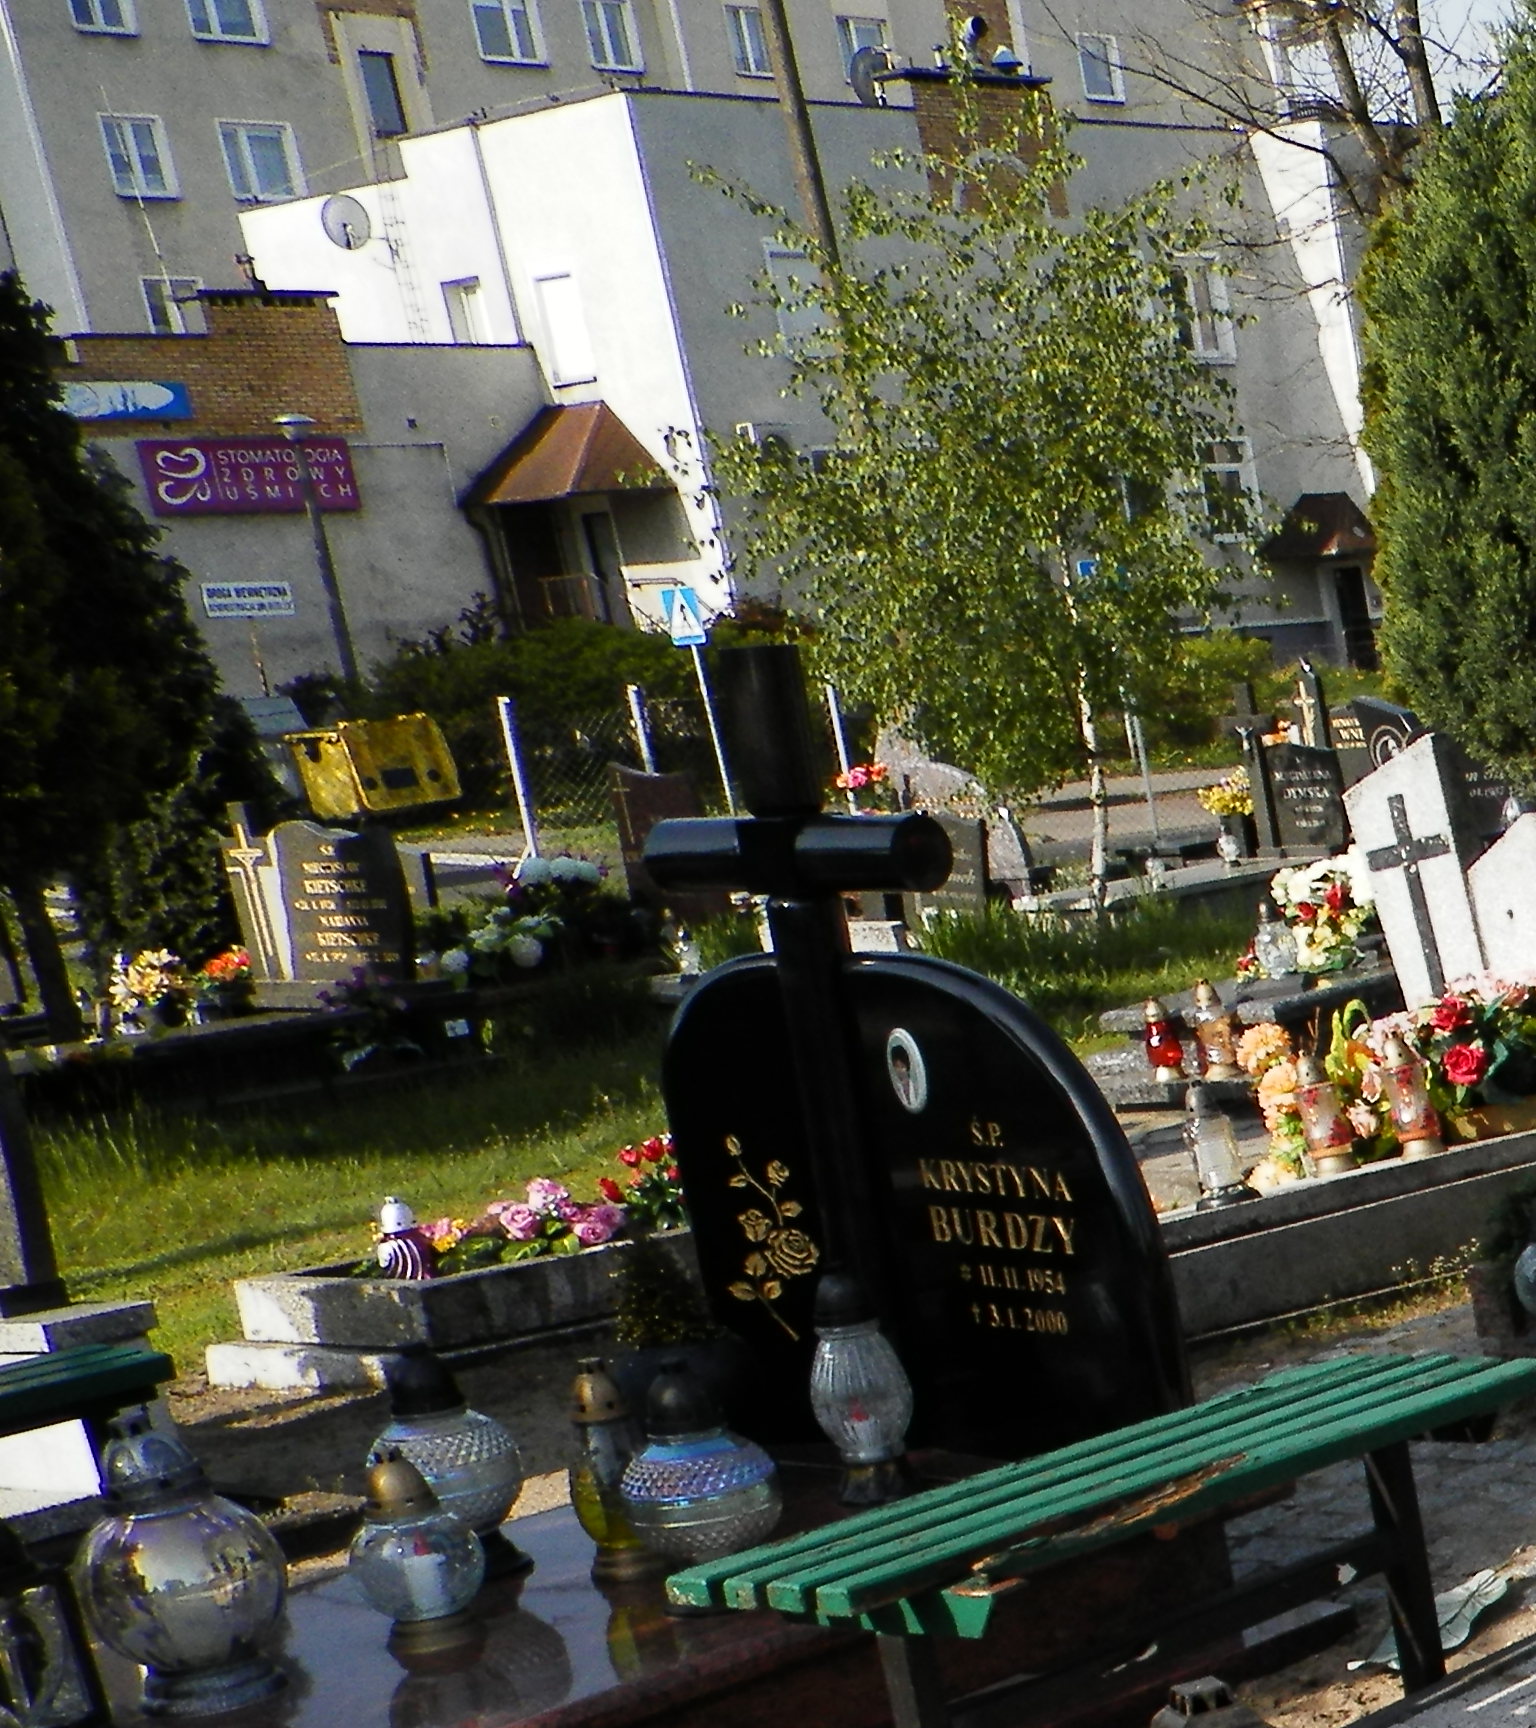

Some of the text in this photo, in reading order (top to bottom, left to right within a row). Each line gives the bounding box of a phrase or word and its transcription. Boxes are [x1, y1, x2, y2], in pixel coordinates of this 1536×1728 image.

[217, 448, 343, 465] STOMATOOGIA
[226, 482, 352, 501] UŚMICH
[919, 1158, 1073, 1202] KRYSTYNA
[928, 1205, 1075, 1255] BURDZY
